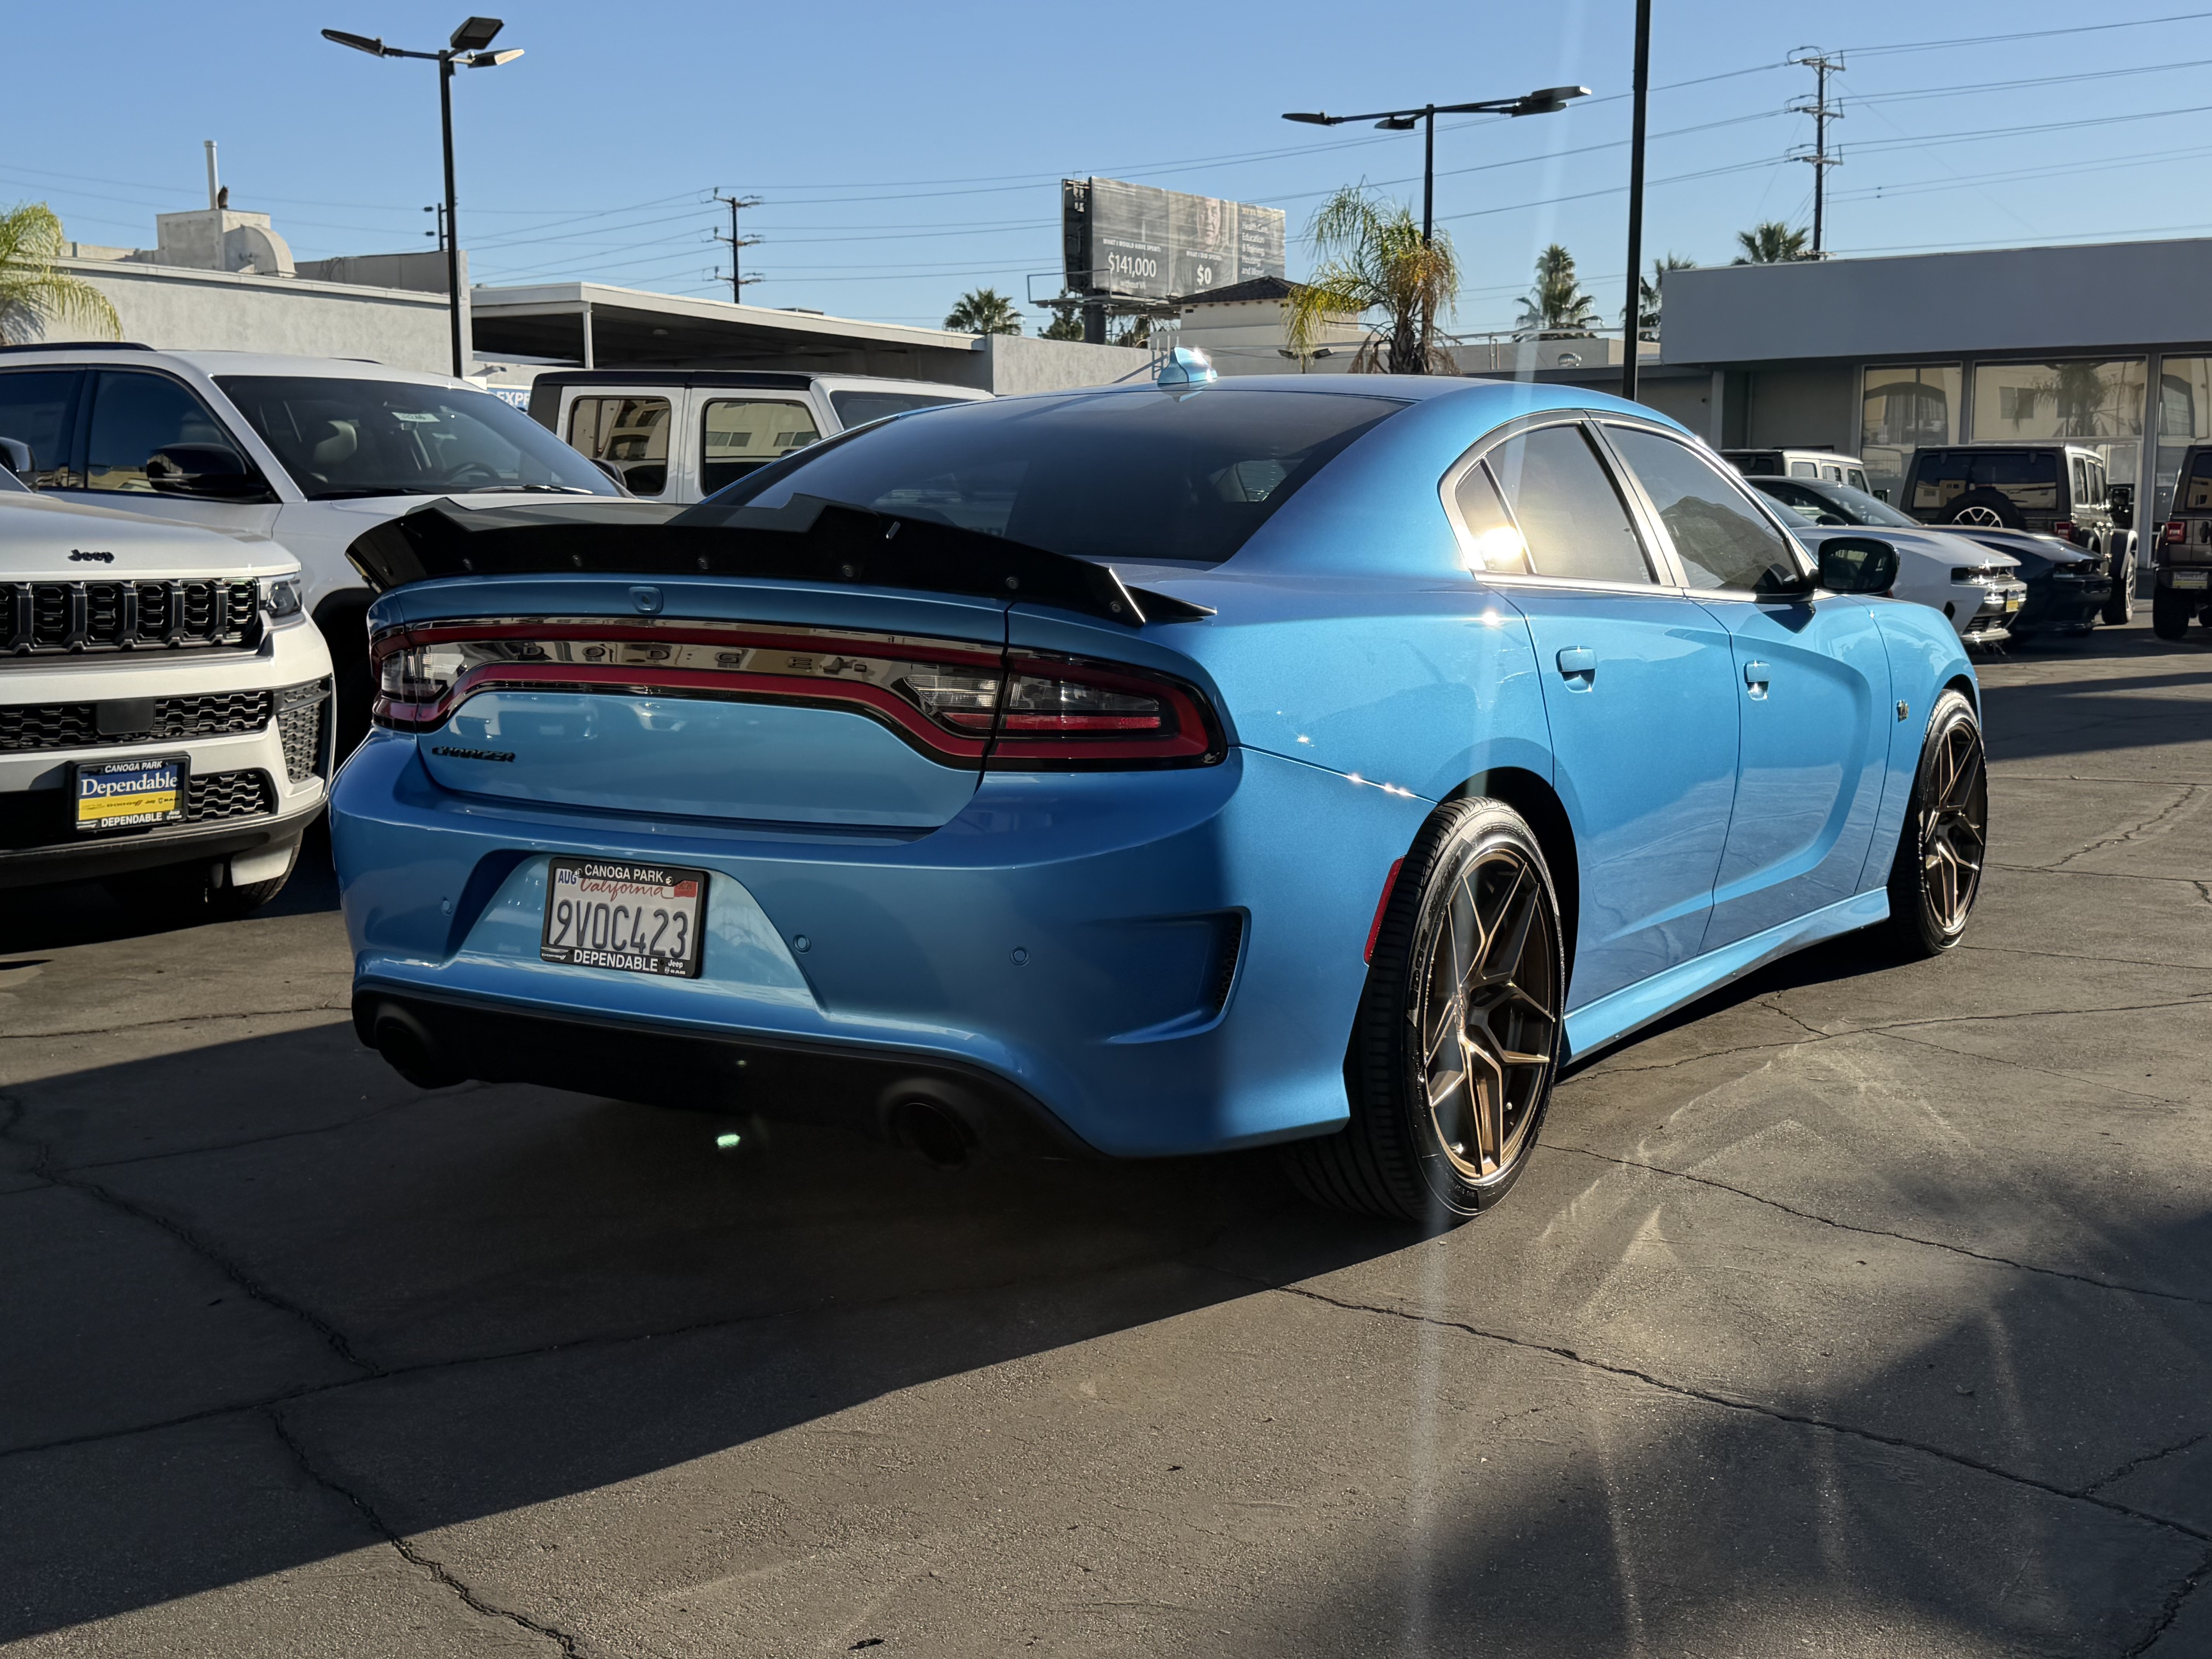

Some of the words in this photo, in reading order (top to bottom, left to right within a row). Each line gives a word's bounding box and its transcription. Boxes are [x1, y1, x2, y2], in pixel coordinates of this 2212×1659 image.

[1108, 252, 1157, 278] $141,000
[1197, 264, 1212, 285] $0
[67, 549, 115, 564] Jeep
[105, 763, 139, 773] CANOGA
[141, 761, 163, 770] PARK
[81, 771, 178, 797] Dependable
[101, 812, 163, 828] DEPENDABLE
[558, 870, 577, 885] AUG
[584, 864, 631, 880] CANOGA
[633, 869, 664, 883] PARK
[580, 878, 674, 902] California
[554, 899, 689, 958] 9VOC423
[574, 949, 658, 972] DEPENDABLE
[668, 959, 684, 969] Jeep
